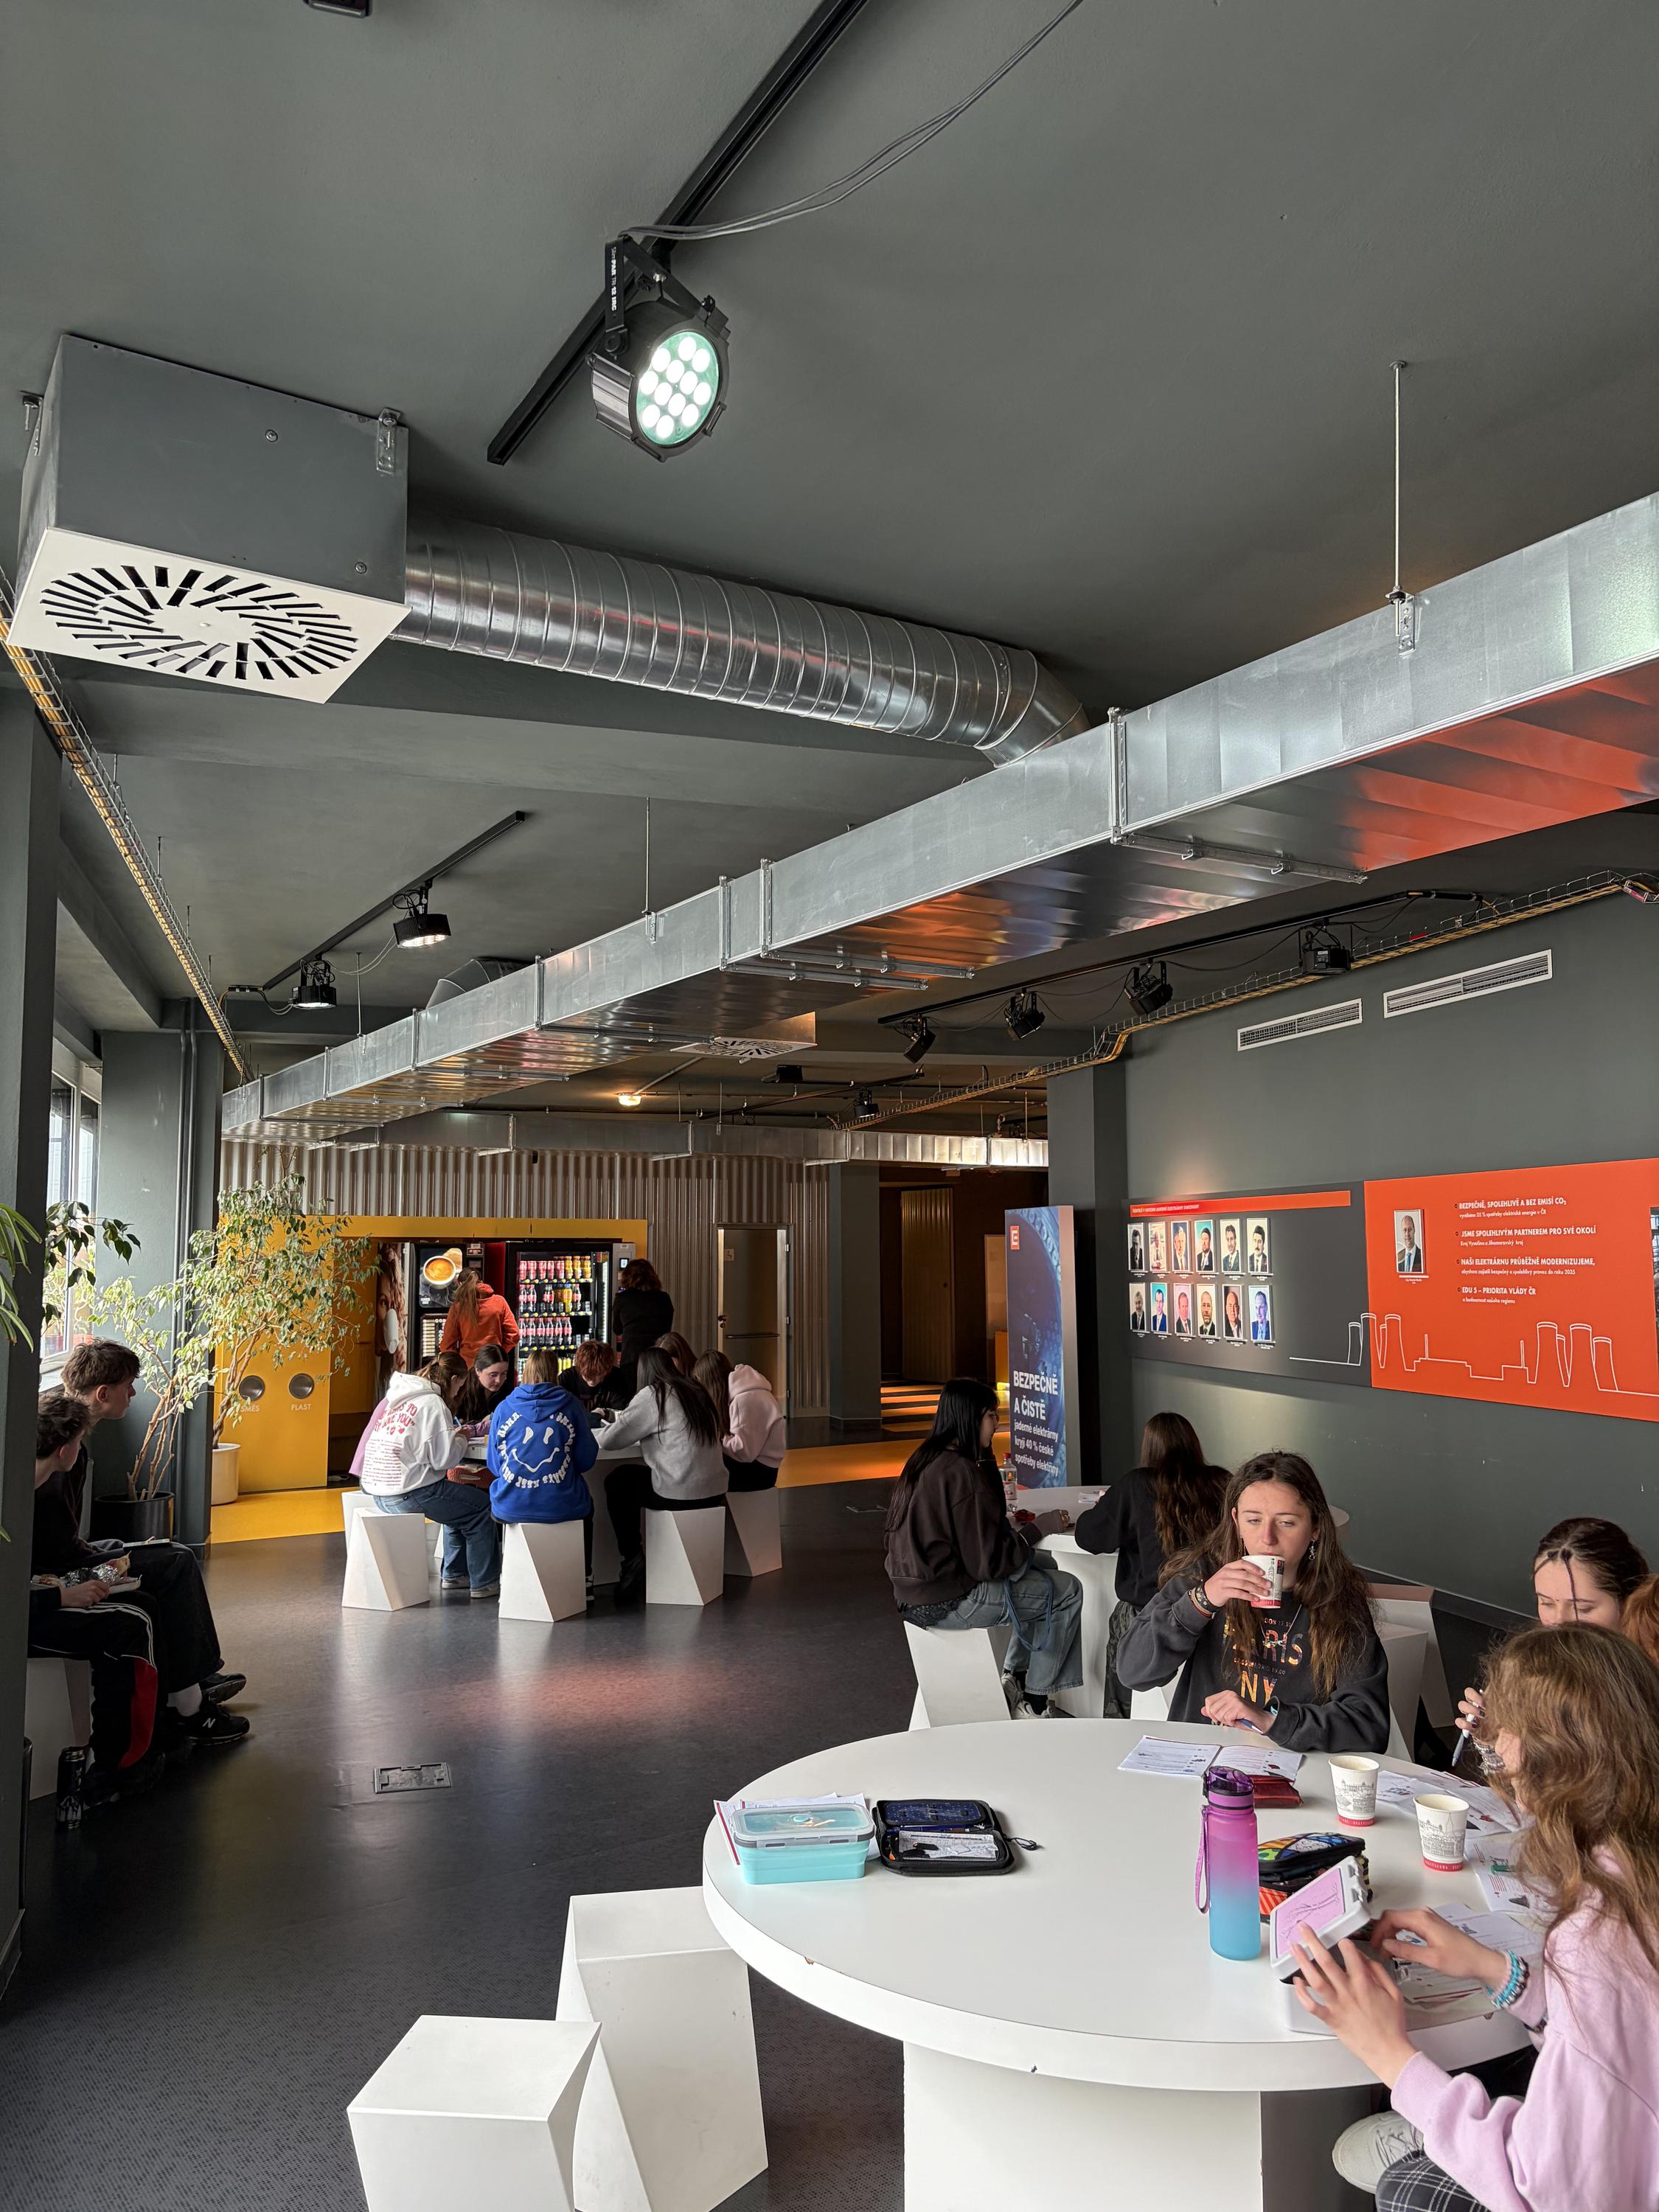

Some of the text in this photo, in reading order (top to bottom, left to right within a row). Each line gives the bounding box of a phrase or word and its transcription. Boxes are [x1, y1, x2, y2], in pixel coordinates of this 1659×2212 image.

[611, 286, 616, 296] 12
[1538, 1196, 1554, 1206] EMISÍ
[1475, 1228, 1513, 1237] SPOLEHLIVÝM
[1563, 1225, 1574, 1234] SVÉ
[1576, 1225, 1596, 1234] OKOLÍ
[1461, 1256, 1596, 1267] NAŠI ELEKTRÁRNU PRŮBĚŽNĚ MODERNIZUJEME,
[1509, 1286, 1527, 1295] VLÁDY
[1528, 1286, 1536, 1295] ČR
[1013, 1370, 1058, 1396] BEZPEČNĚ
[1014, 1394, 1046, 1421] A ČISTĚ
[1014, 1419, 1059, 1443] jaderné elektrárny
[1015, 1435, 1054, 1456] kryjí 40 % české
[1015, 1453, 1059, 1477] spotřeby elektřiny
[1240, 1669, 1278, 1705] NY
